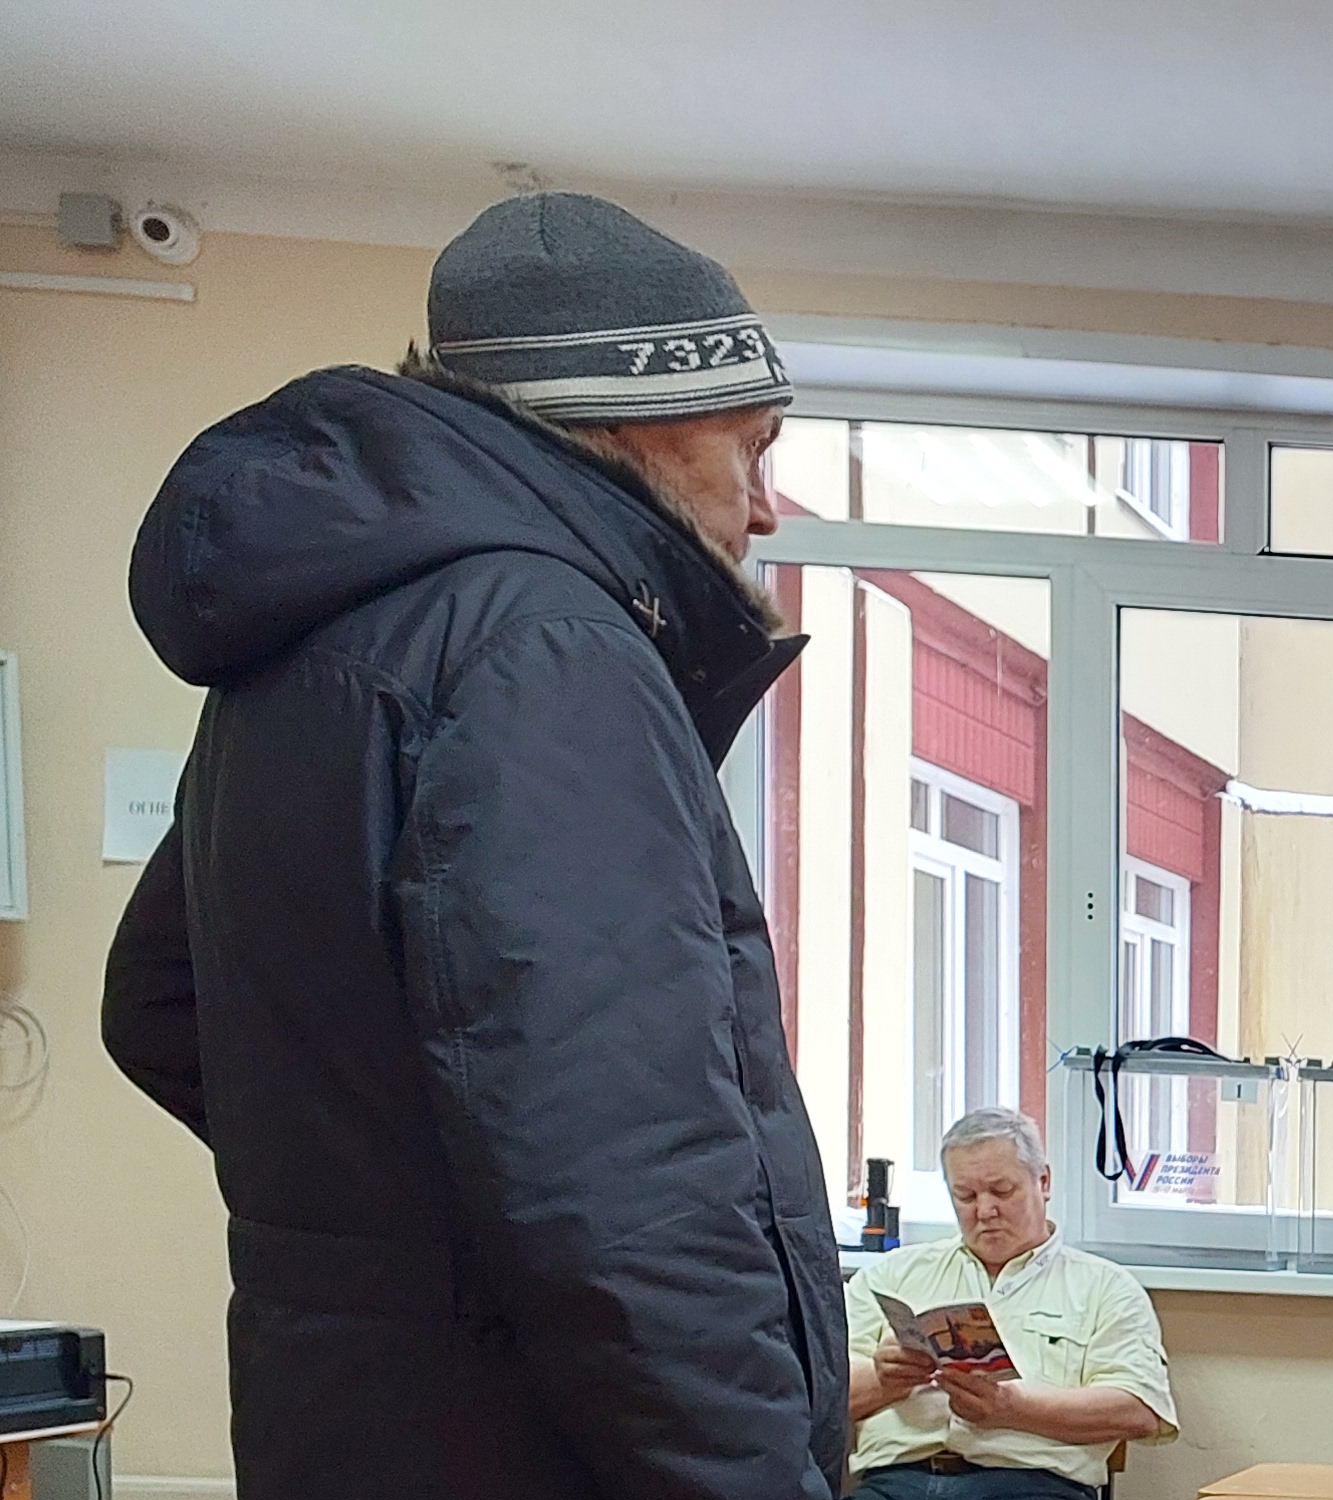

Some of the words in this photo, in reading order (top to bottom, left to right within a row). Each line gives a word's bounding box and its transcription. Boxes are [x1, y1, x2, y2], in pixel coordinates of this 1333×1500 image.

[1236, 1083, 1243, 1099] 1
[1164, 1153, 1209, 1164] ВЫБОРЫ
[1160, 1164, 1221, 1176] ПРЕЗИДЕНТА
[1155, 1175, 1195, 1186] РОССИИ
